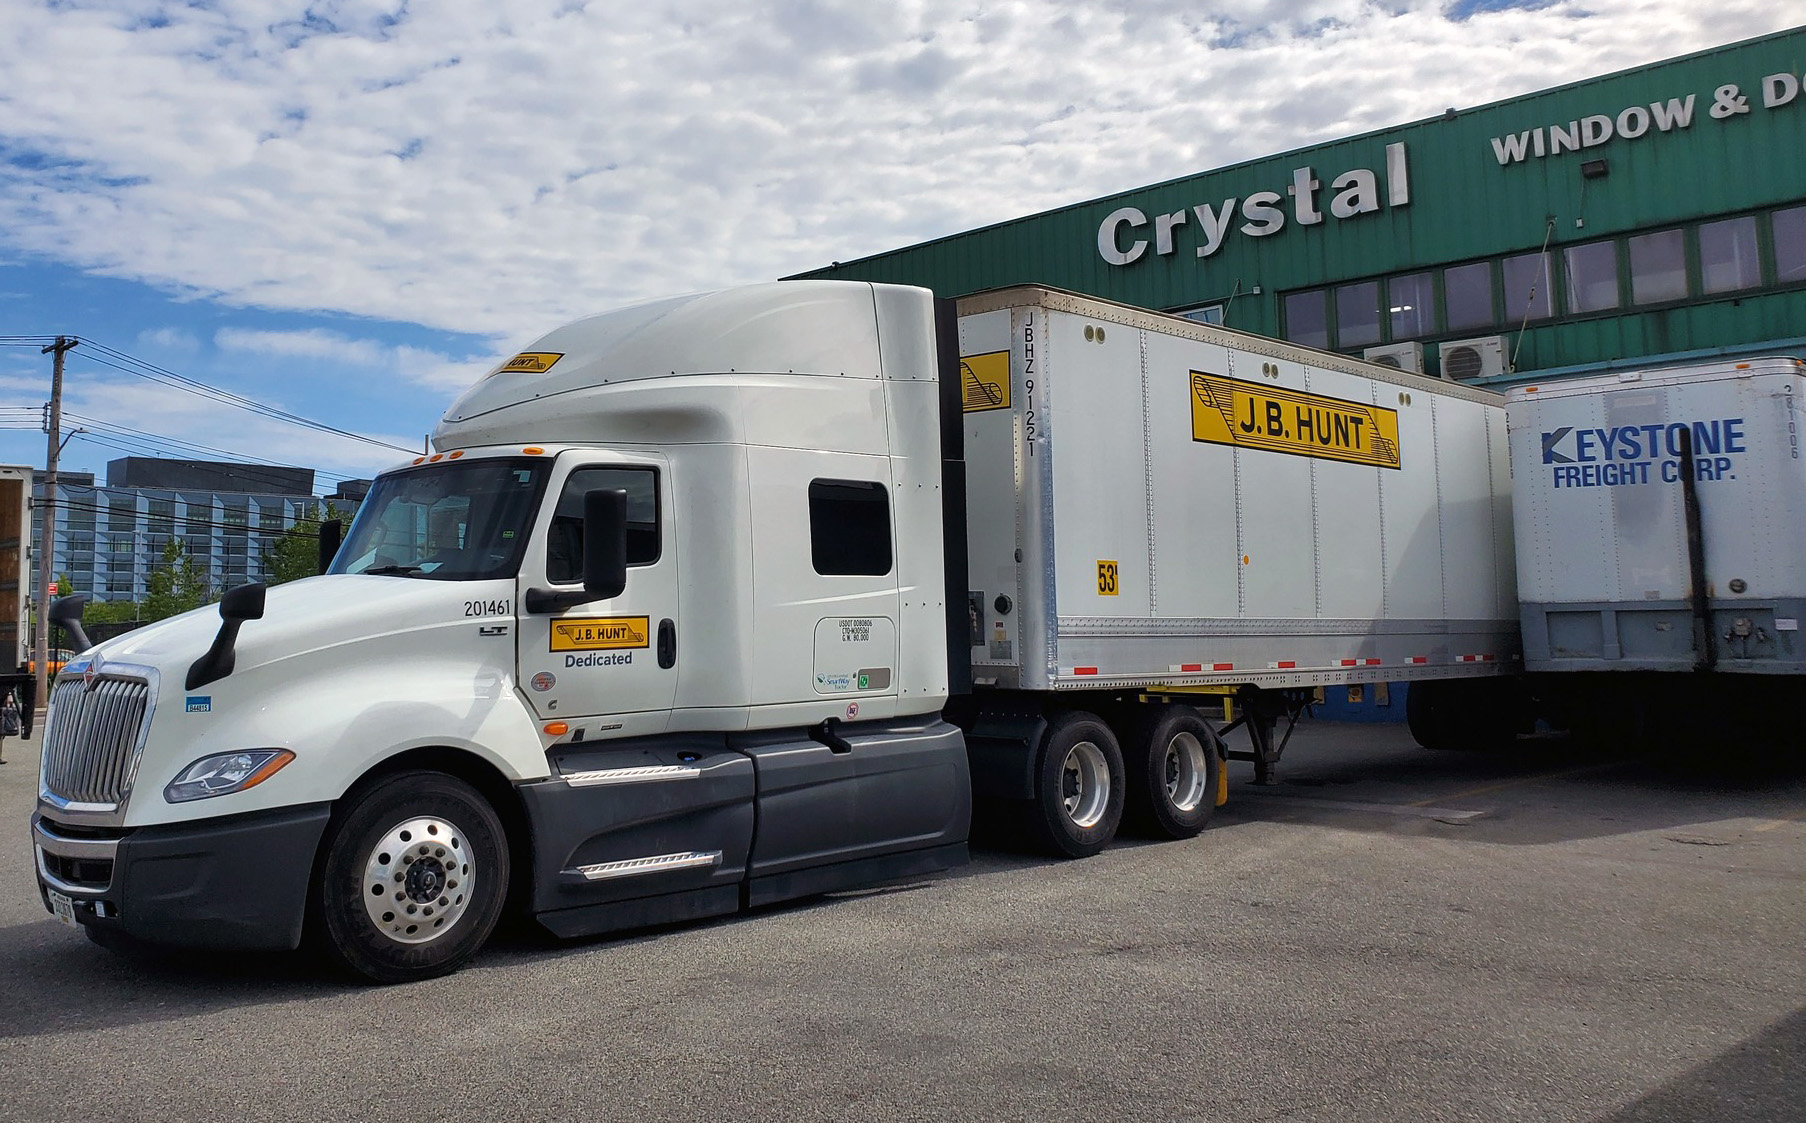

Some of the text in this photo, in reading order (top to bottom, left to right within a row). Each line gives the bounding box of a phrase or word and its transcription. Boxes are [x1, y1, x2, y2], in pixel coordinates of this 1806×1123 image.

[1490, 72, 1806, 165] WINDOW & D
[1097, 141, 1409, 266] Crystal
[1024, 312, 1036, 456] JBHZ 91221
[1240, 397, 1363, 449] J.B. HUNT
[1541, 418, 1746, 464] KEYSTONE
[1553, 461, 1652, 488] FREIGHT
[464, 600, 510, 616] 201461
[575, 628, 627, 640] J.B. HUNT
[565, 652, 632, 668] Dedicated
